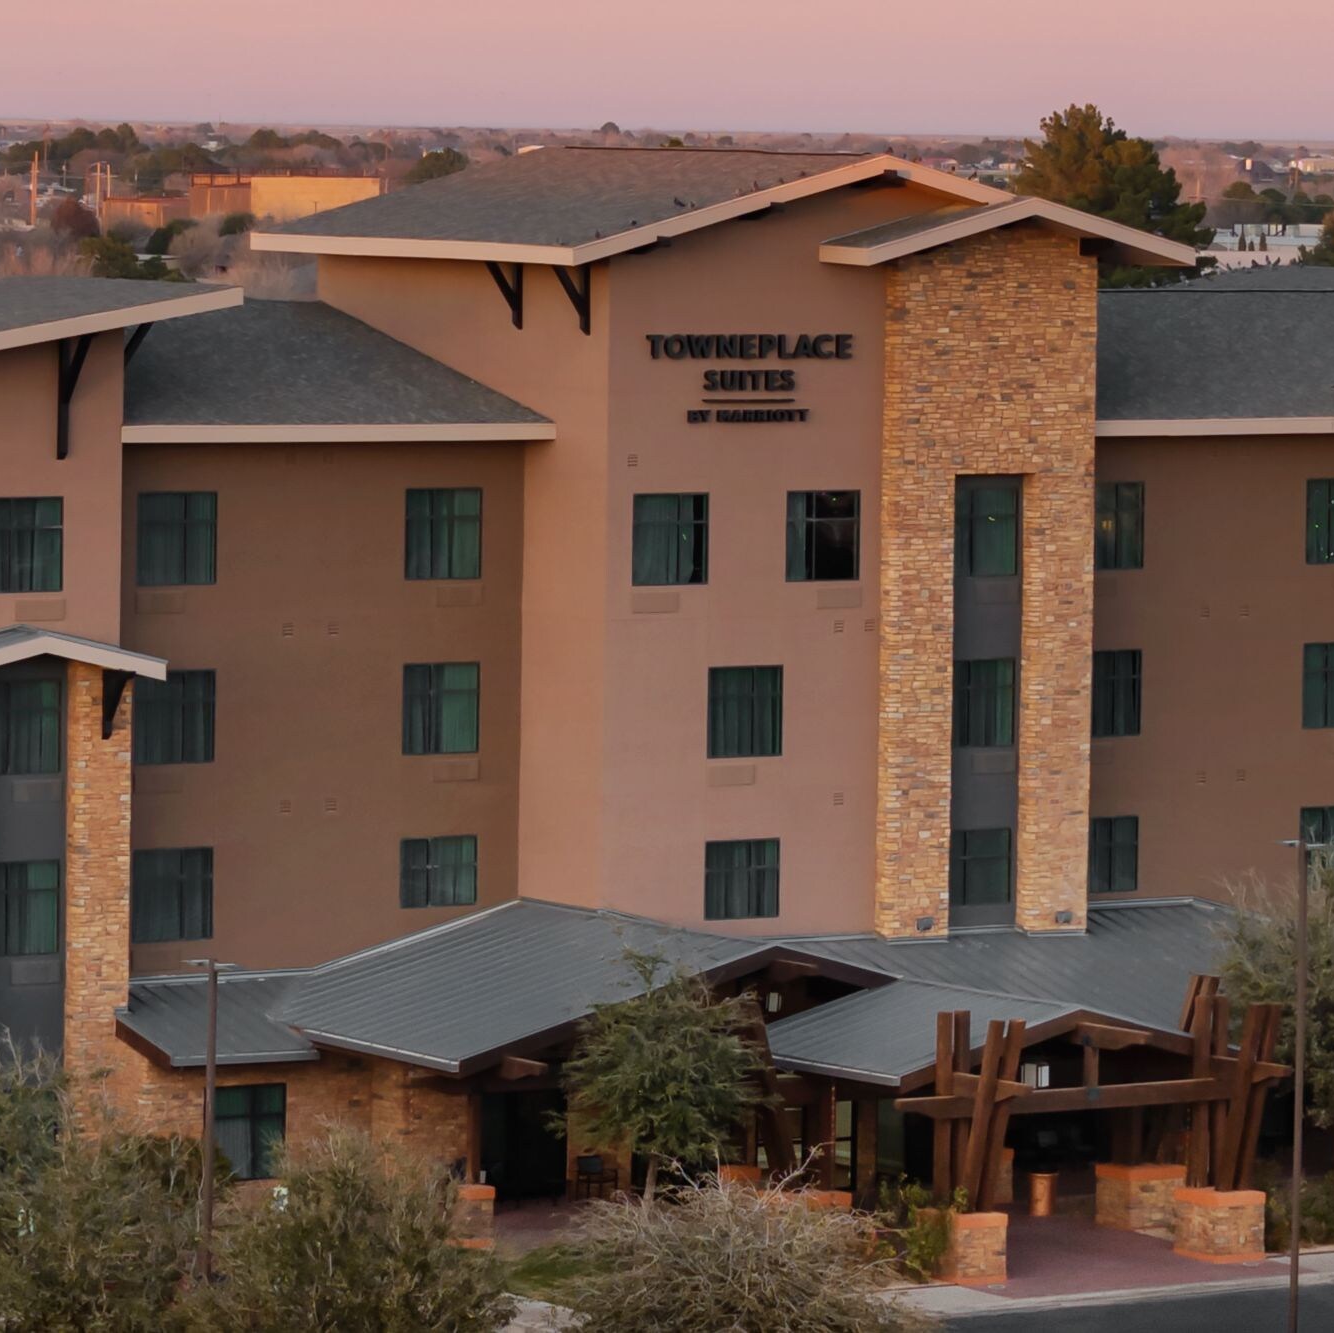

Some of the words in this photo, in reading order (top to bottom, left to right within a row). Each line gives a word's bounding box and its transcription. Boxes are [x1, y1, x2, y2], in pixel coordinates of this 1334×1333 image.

[646, 334, 853, 359] TOWNEPLACE
[703, 369, 796, 391] SUITES
[688, 409, 711, 423] BY
[716, 409, 809, 422] MARRIOTT
